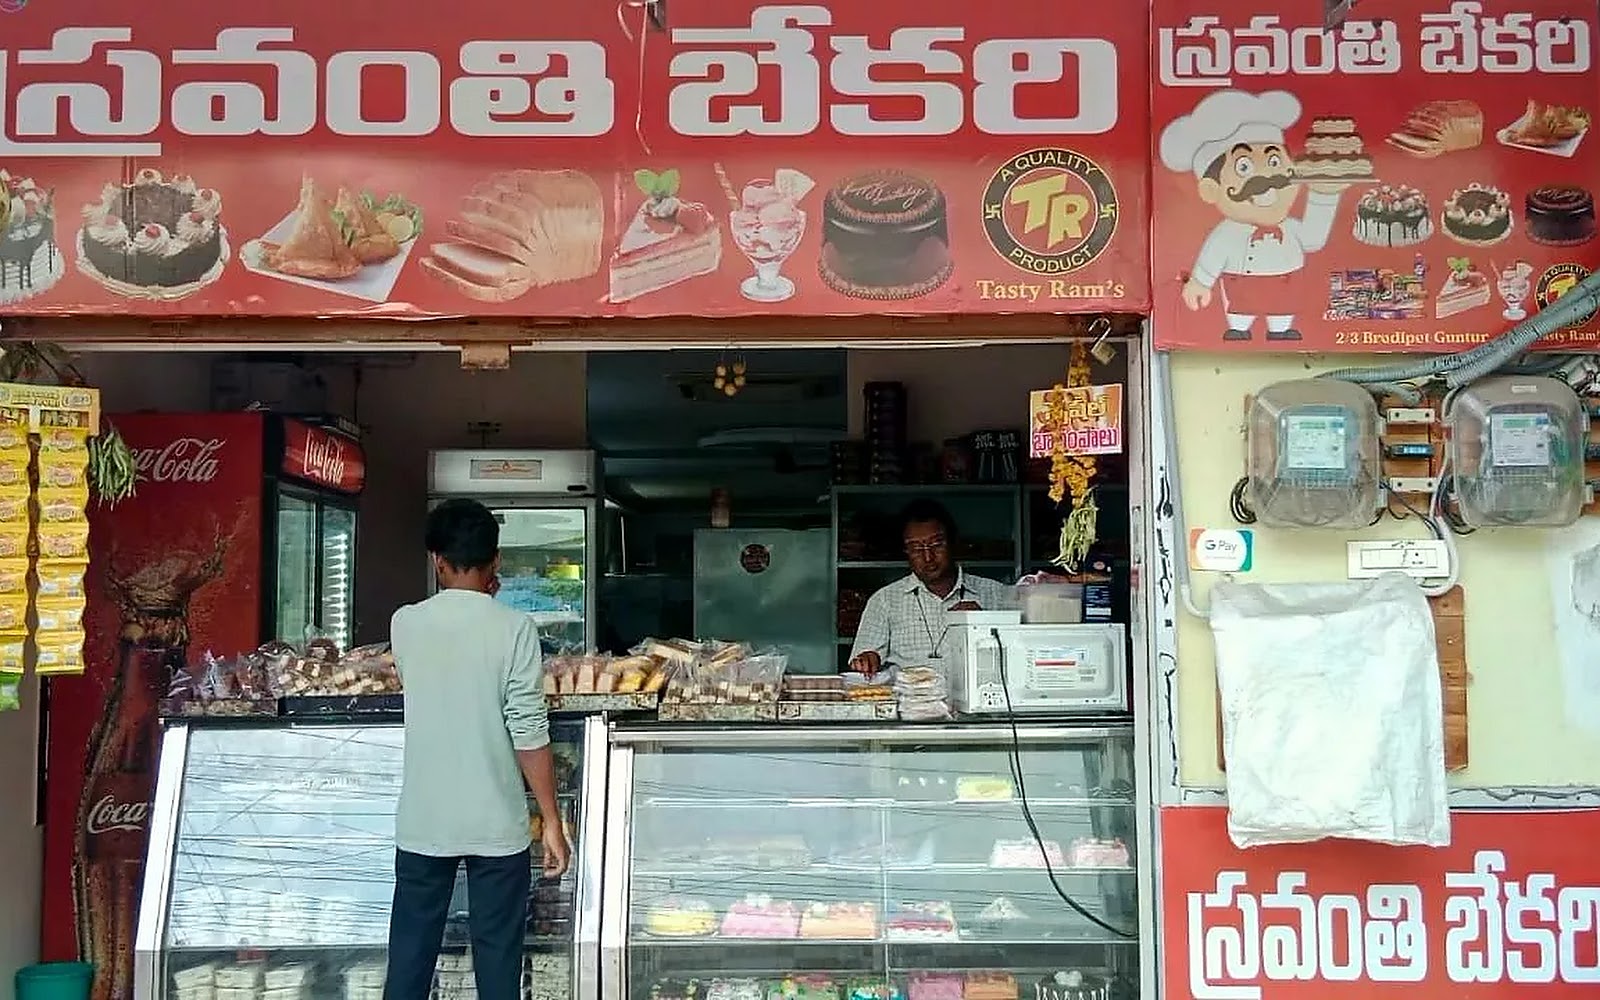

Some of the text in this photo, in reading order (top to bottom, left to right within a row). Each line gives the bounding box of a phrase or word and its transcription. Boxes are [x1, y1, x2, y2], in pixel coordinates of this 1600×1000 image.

[1159, 1, 1590, 86] స్రవంతి బేకరి
[669, 6, 1117, 136] బేకరి
[1000, 151, 1098, 182] A QUALITY
[1010, 173, 1089, 249] TR
[1010, 245, 1093, 273] PRODUCT
[976, 279, 1125, 302] Tasty Ram's
[1033, 428, 1118, 451] బాంపాలు
[1218, 540, 1237, 554] Pay
[1188, 871, 1428, 1000] స్రవంతి
